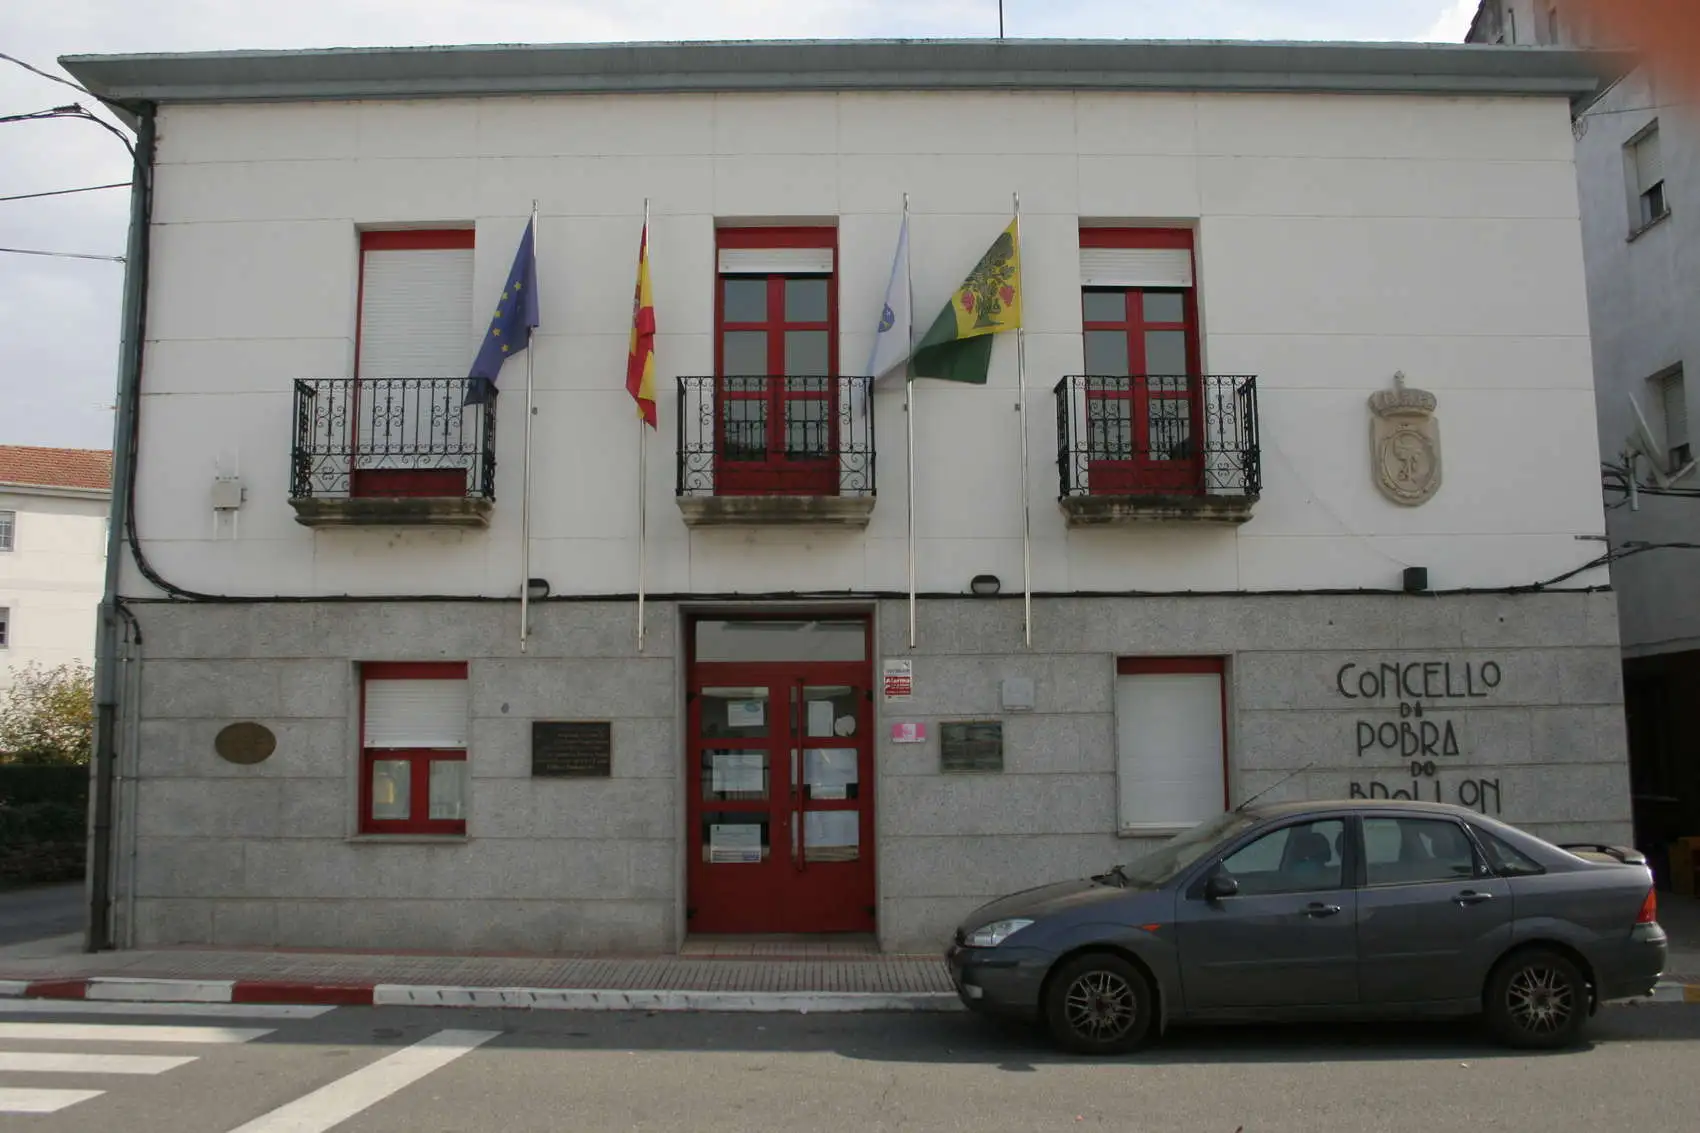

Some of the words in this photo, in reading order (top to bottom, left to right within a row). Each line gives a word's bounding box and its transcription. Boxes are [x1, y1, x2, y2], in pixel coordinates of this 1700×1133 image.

[1337, 661, 1501, 698] CONCELLO
[1357, 720, 1459, 757] POBRA
[1411, 761, 1436, 777] DO
